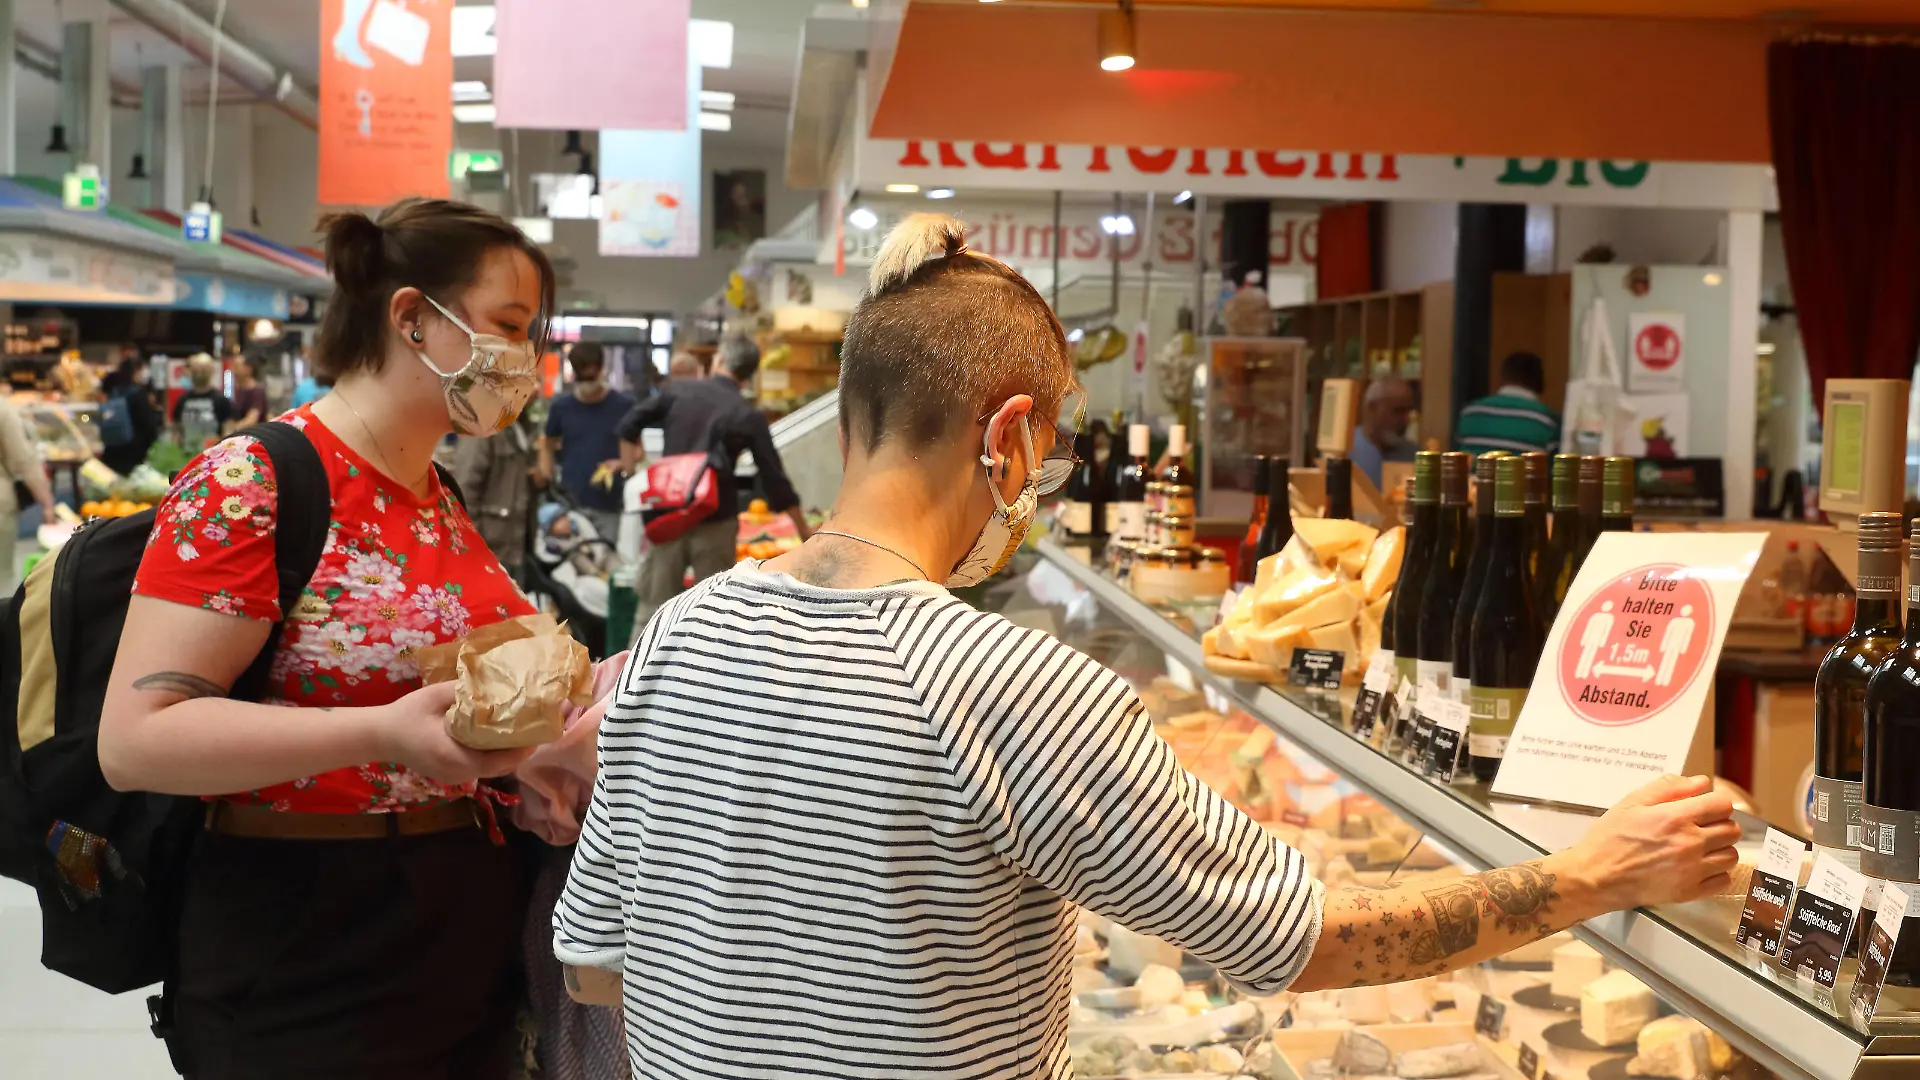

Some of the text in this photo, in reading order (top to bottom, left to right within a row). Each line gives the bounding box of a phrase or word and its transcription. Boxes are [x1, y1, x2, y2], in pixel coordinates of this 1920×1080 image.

[1638, 573, 1678, 592] Bitte
[1622, 597, 1674, 615] halten
[1626, 620, 1652, 638] Sie
[1609, 642, 1650, 664] 1,5m
[1579, 684, 1650, 708] Abstand.
[1798, 907, 1828, 929] Stöffelche
[1826, 918, 1843, 935] Rosé
